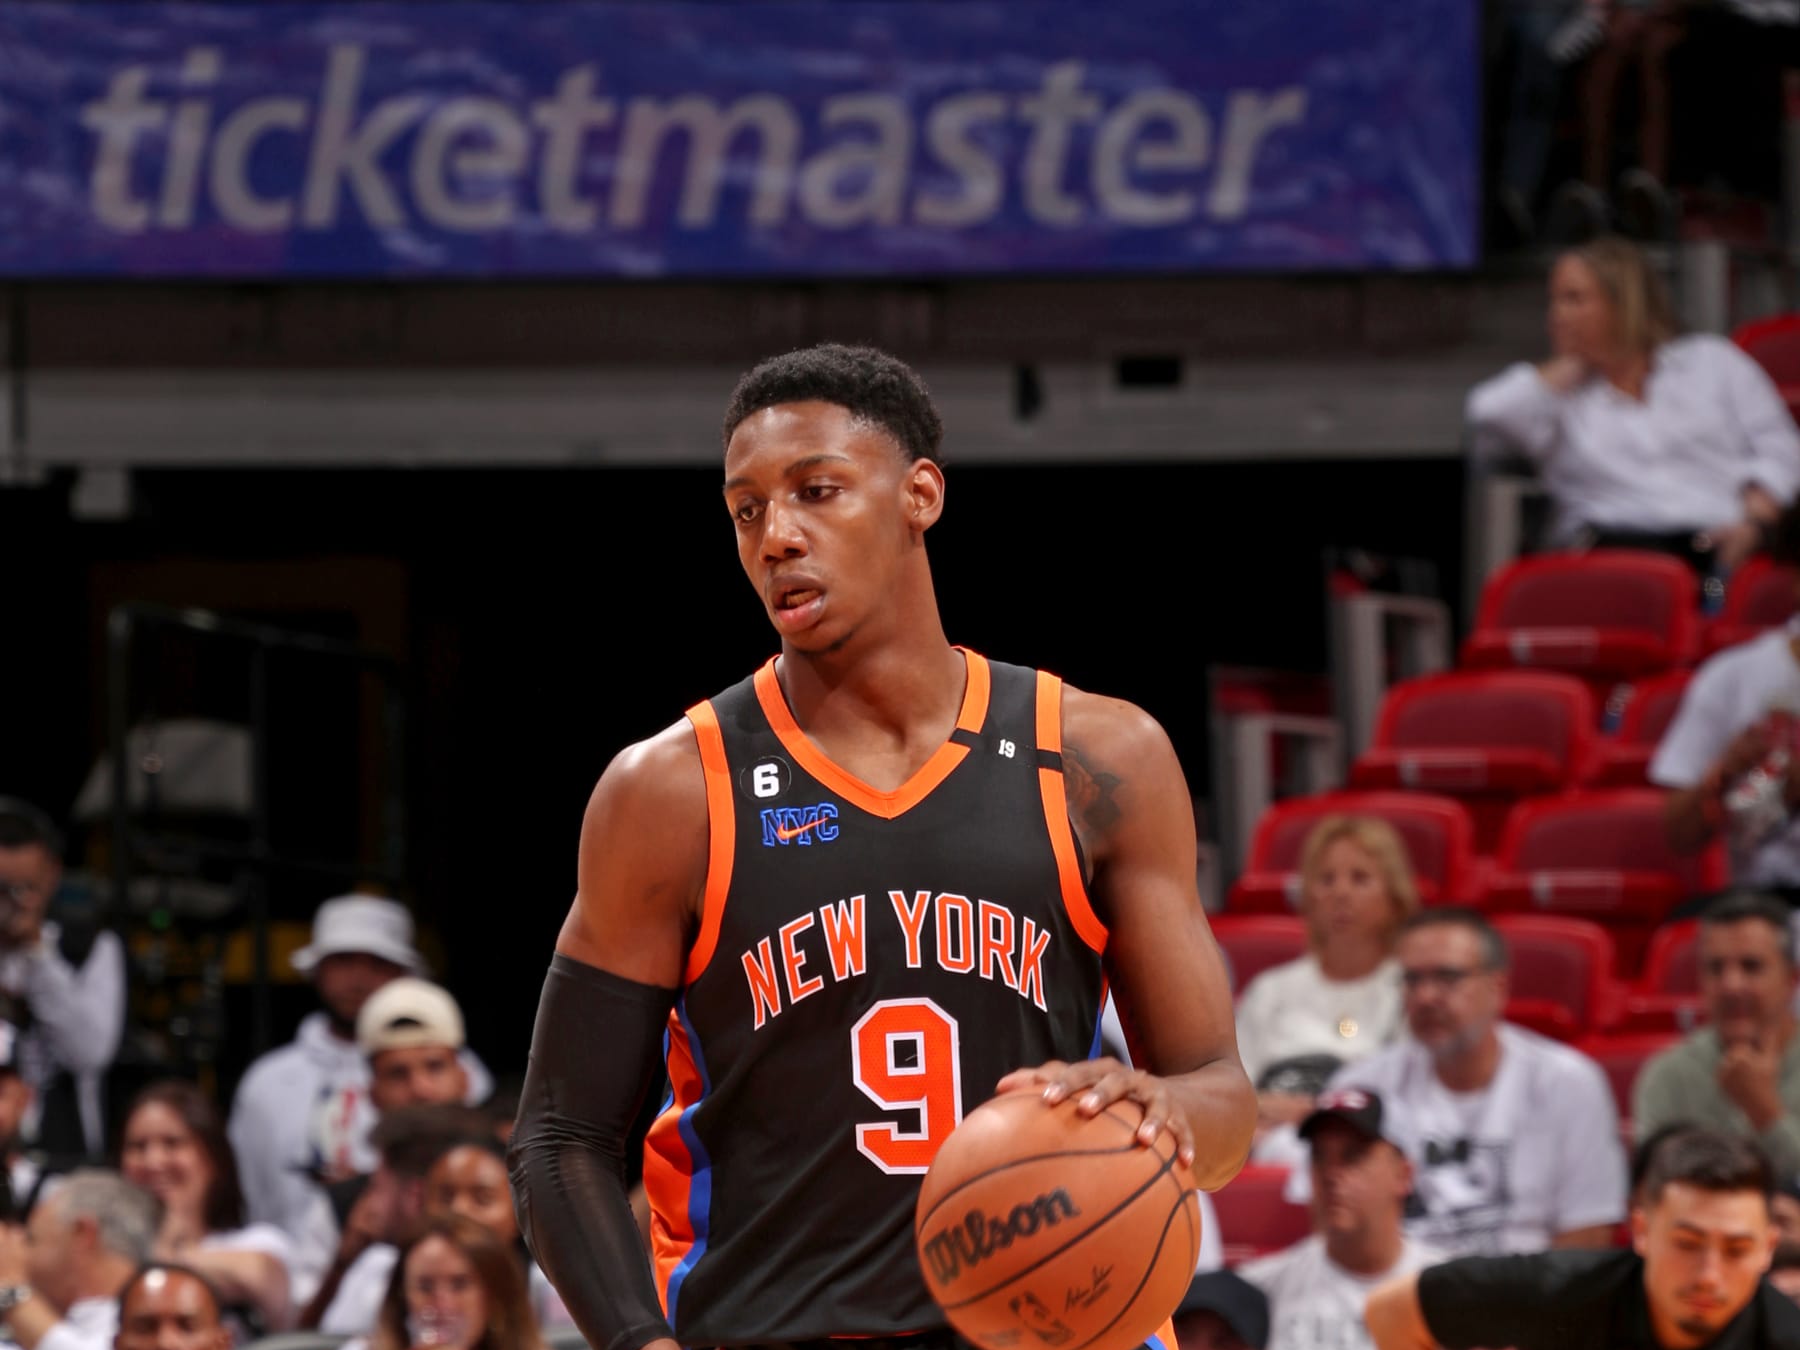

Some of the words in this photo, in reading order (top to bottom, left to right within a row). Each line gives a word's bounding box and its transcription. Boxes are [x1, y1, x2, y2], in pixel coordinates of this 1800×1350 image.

[84, 44, 1308, 232] ticketmaster
[753, 763, 780, 798] 6
[998, 738, 1016, 759] 19
[760, 803, 839, 847] NYC
[740, 894, 867, 1031] NEW
[887, 890, 1052, 1013] YORK
[850, 997, 964, 1175] 9
[923, 1187, 1082, 1286] Wilson
